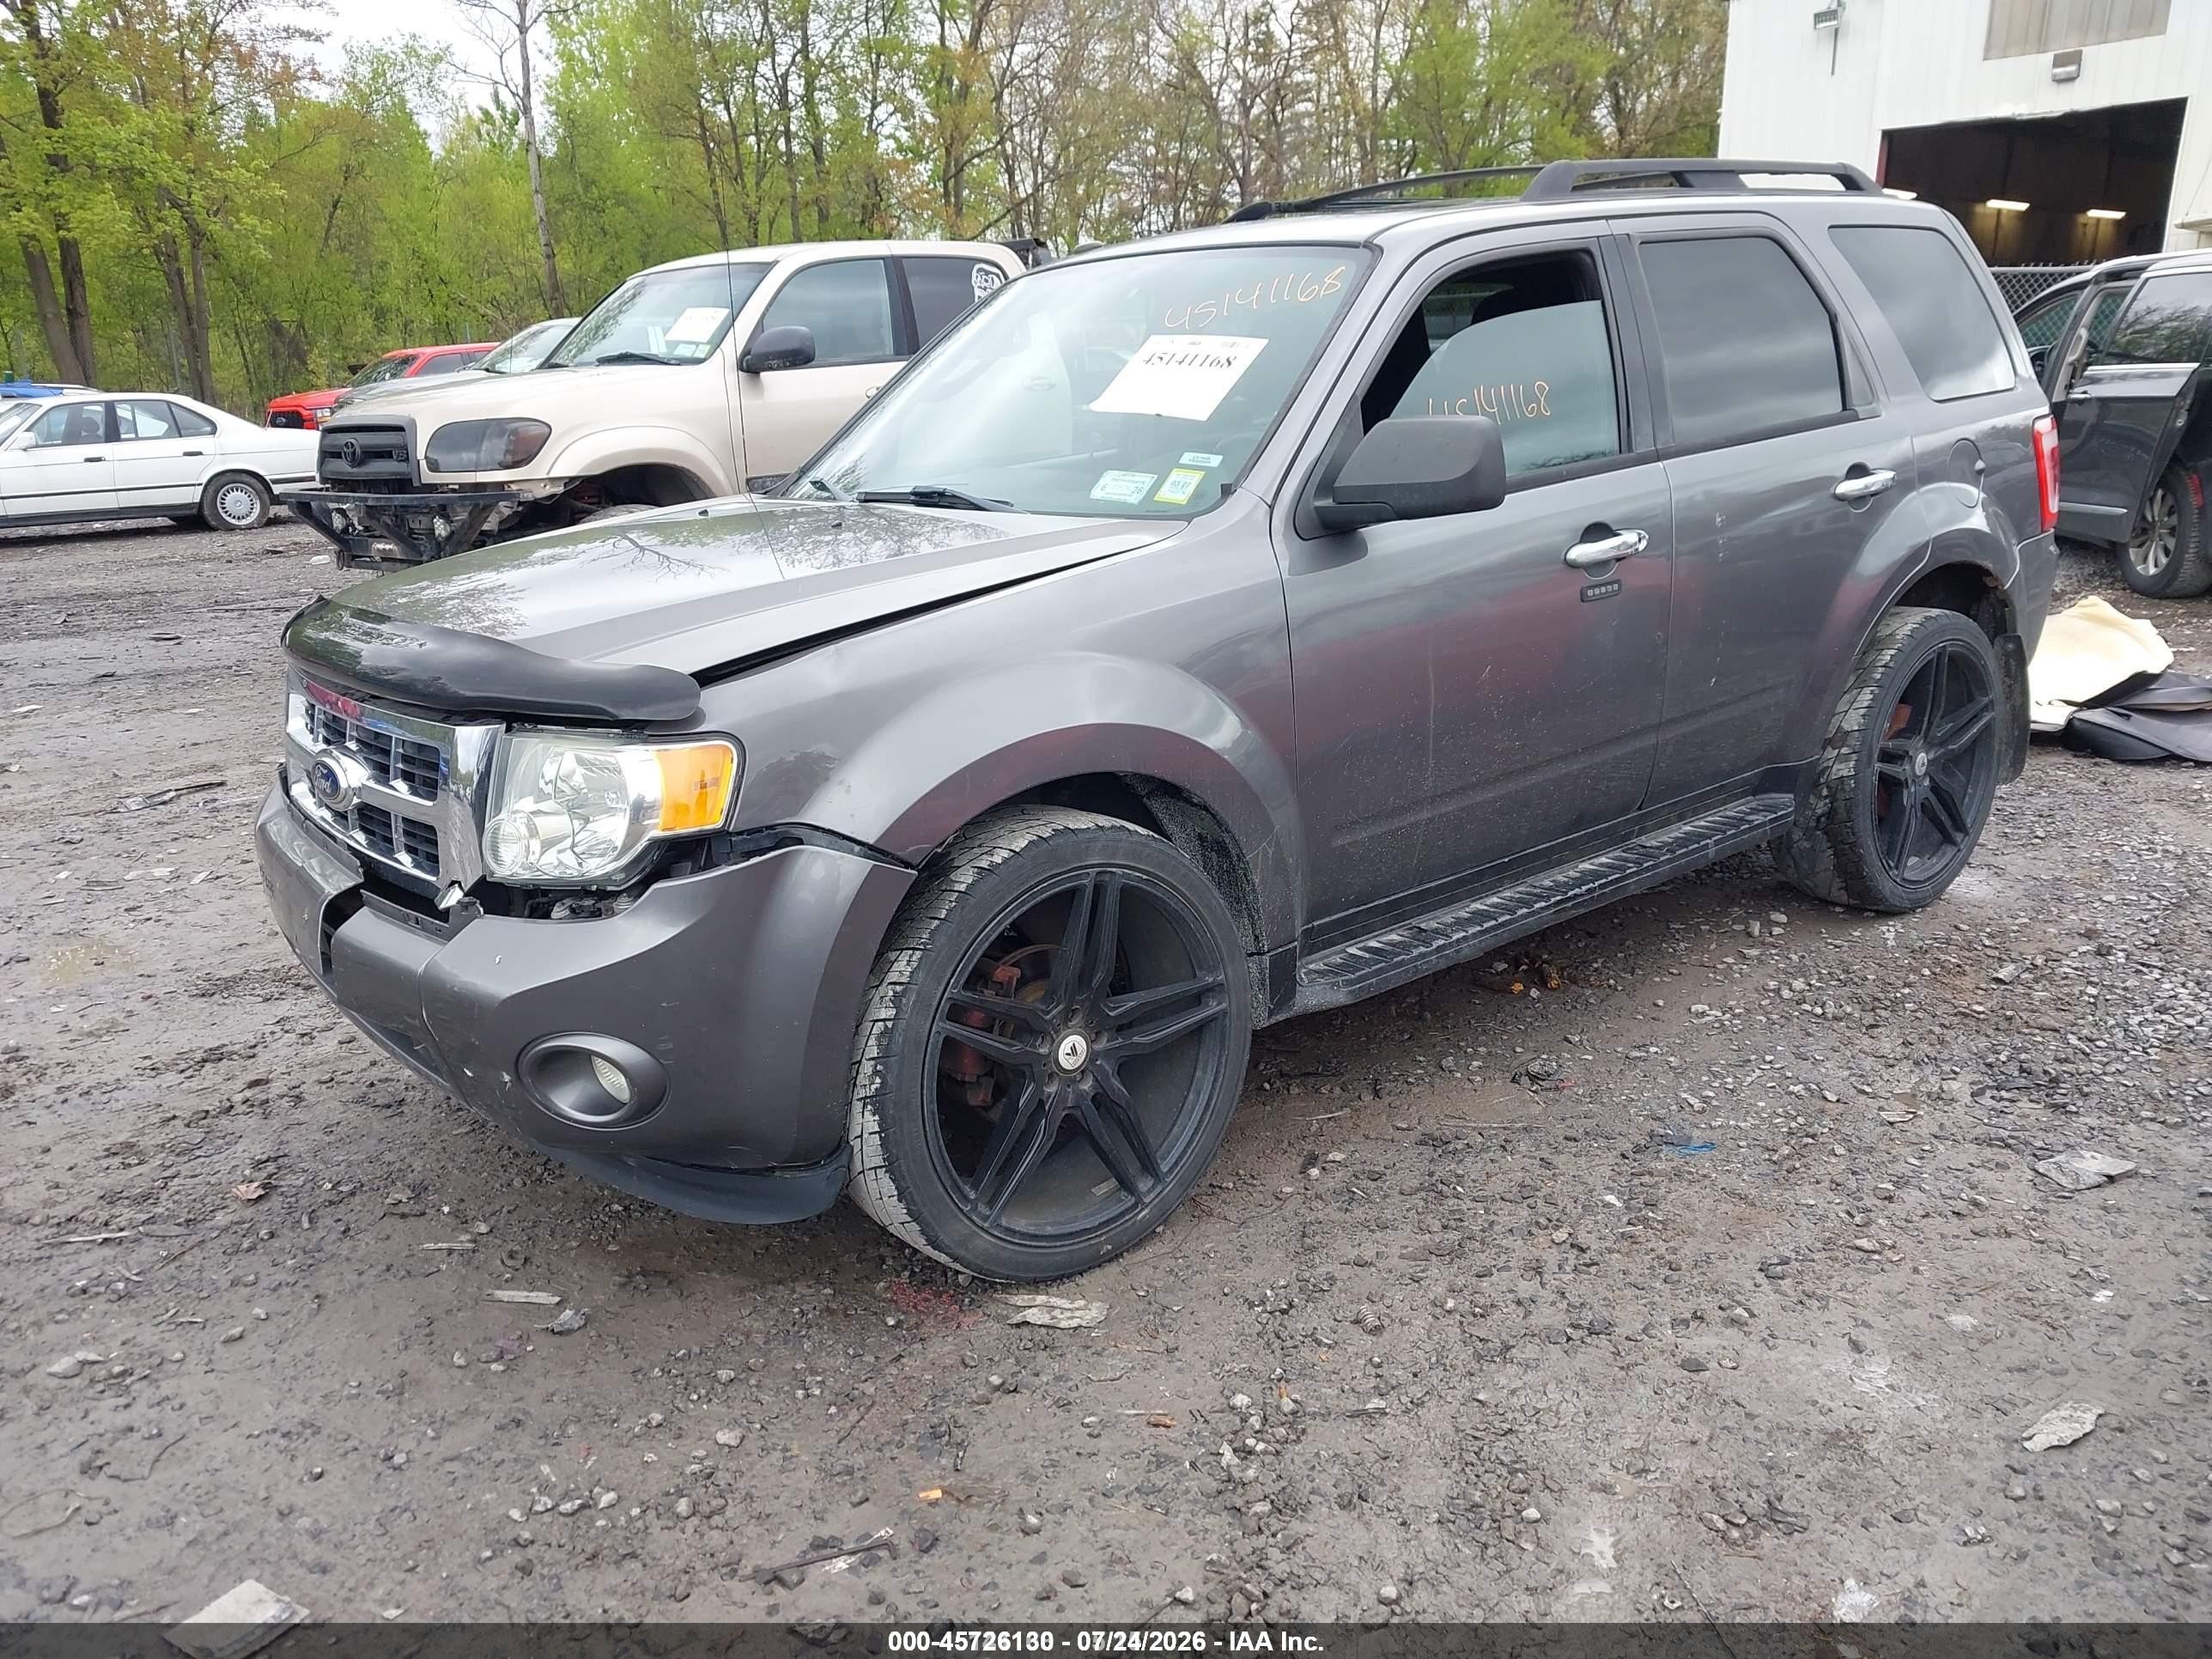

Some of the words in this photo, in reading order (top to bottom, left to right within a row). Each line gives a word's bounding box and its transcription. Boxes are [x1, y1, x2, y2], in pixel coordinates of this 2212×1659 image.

[1164, 267, 1346, 330] 45141168
[1142, 352, 1238, 370] 45141168
[313, 764, 332, 793] Ford
